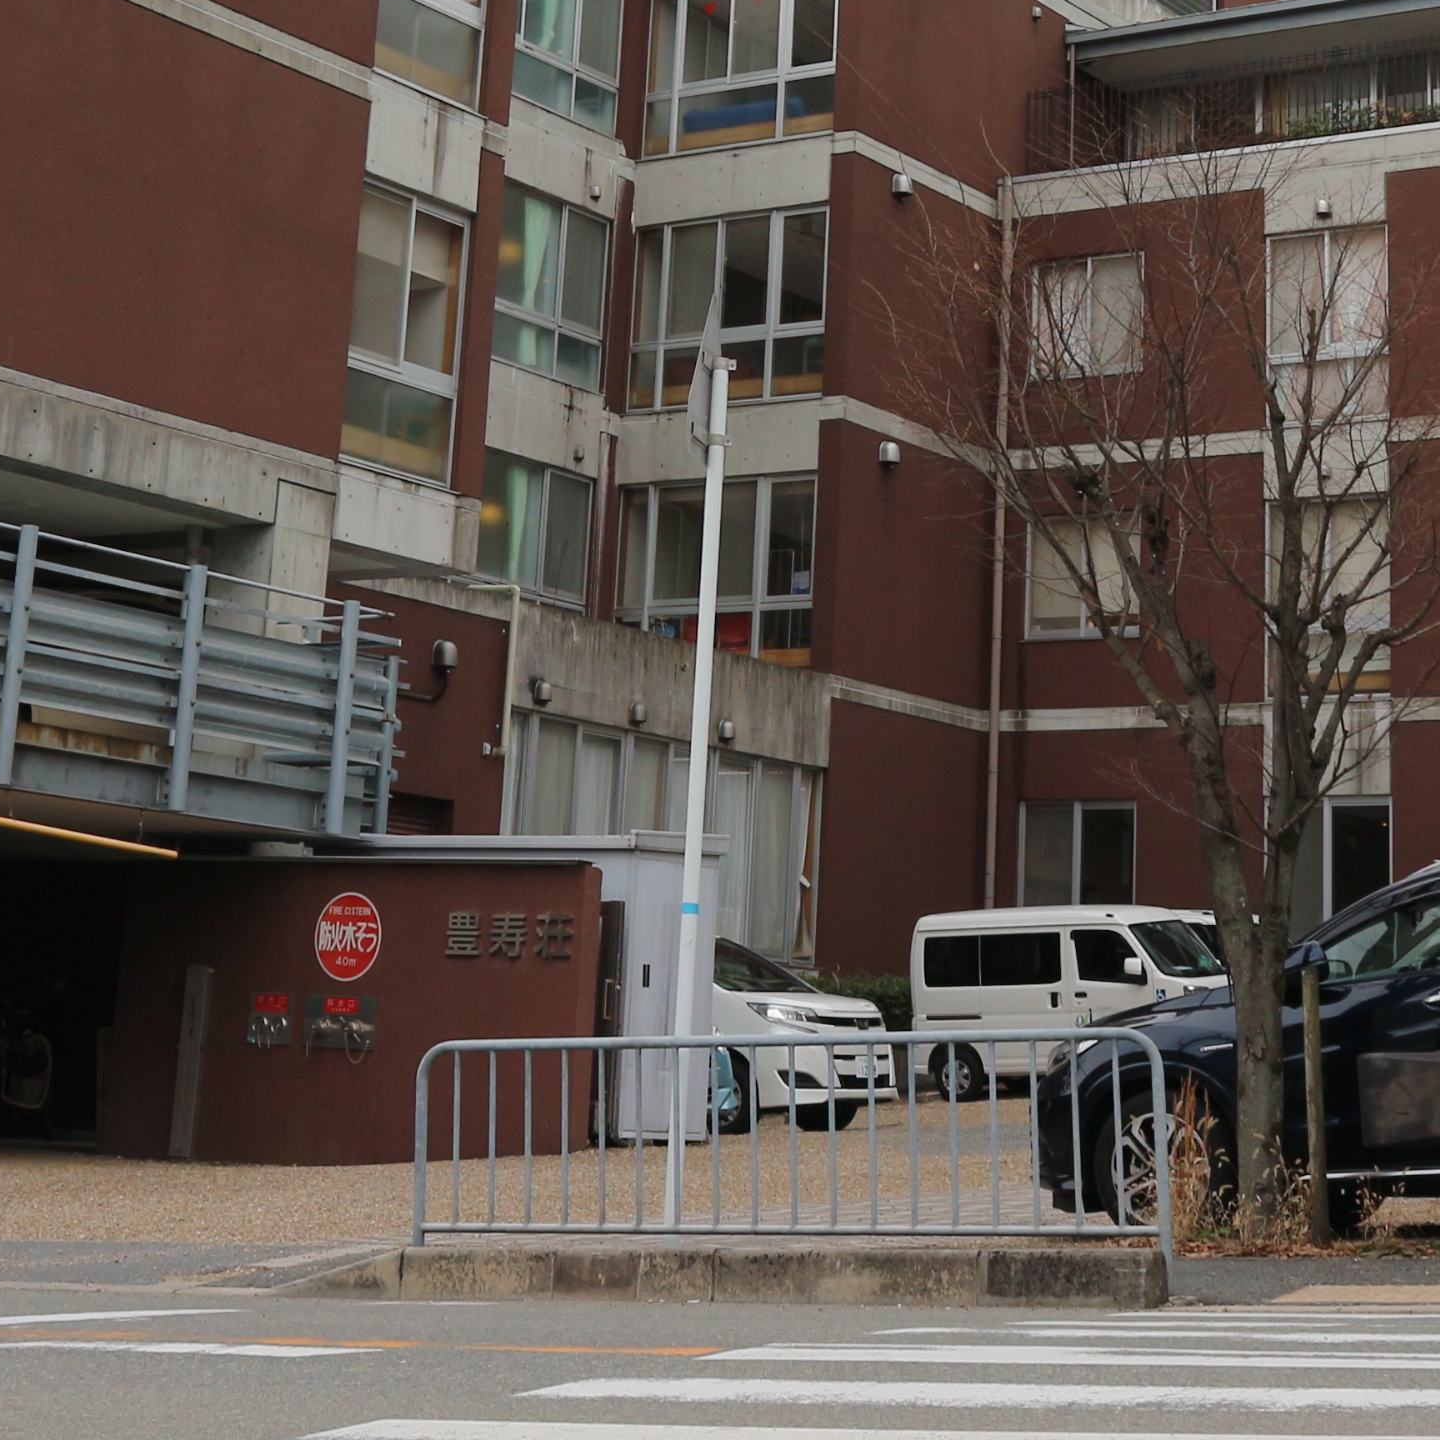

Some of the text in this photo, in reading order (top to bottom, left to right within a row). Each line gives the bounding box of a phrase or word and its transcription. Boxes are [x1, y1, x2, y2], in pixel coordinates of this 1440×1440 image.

[329, 906, 372, 916] FIRE CISTERN
[319, 921, 378, 953] 防火水そう
[444, 910, 575, 958] 豊寿荘
